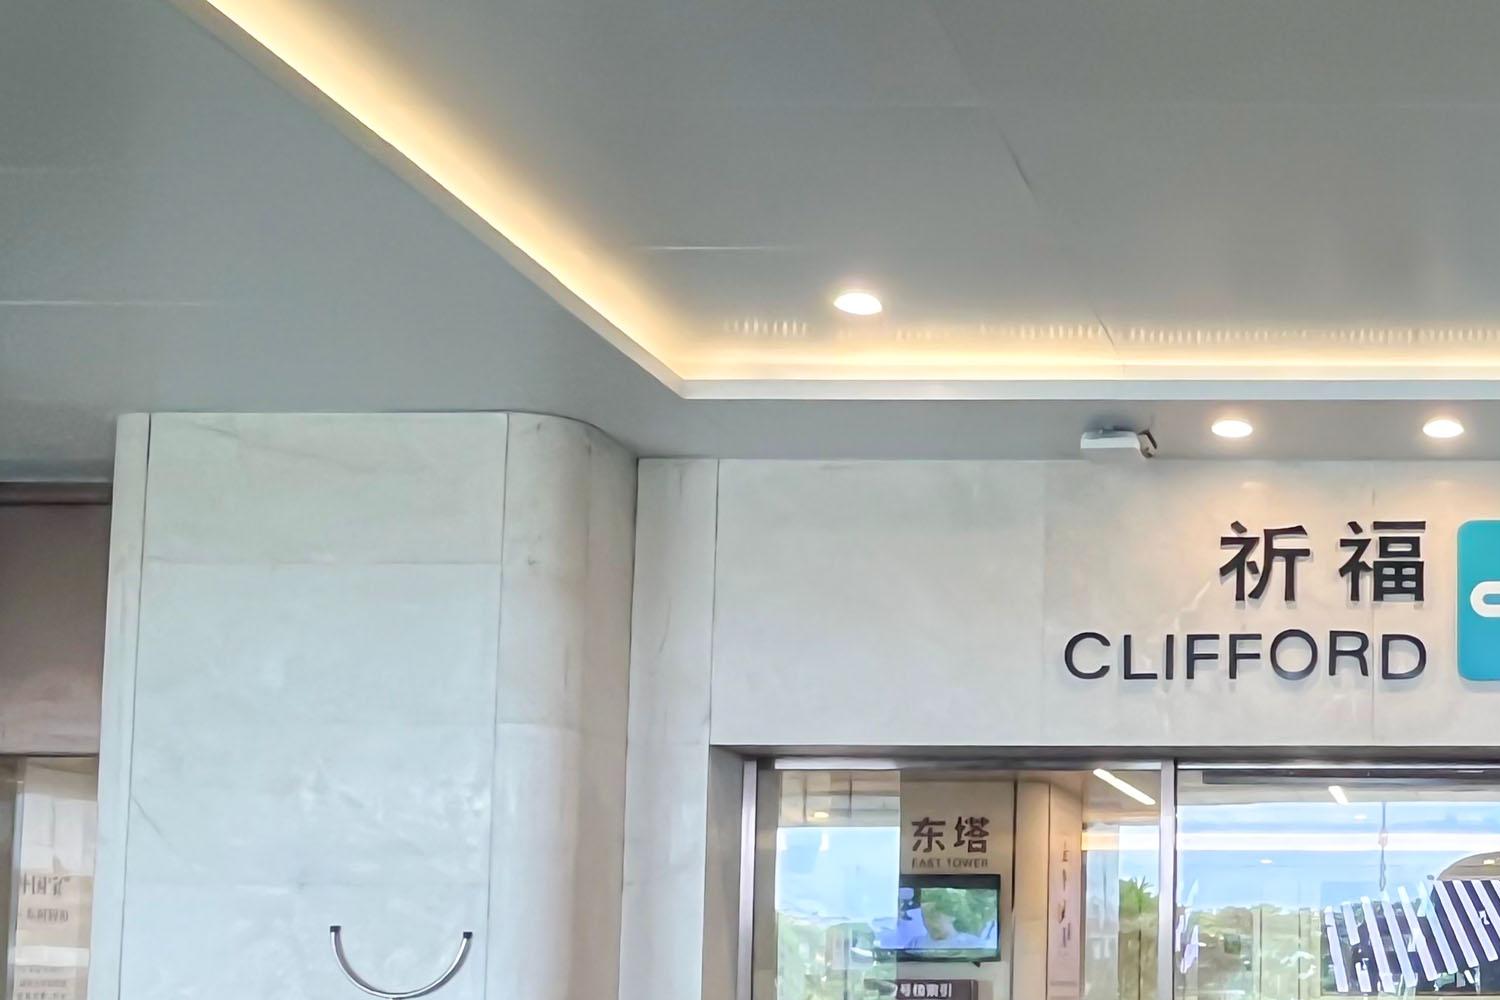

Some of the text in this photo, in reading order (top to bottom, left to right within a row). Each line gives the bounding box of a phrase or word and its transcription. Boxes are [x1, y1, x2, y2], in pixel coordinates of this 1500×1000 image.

[1219, 521, 1427, 602] 祈福
[1064, 629, 1427, 681] CLIFFORD
[911, 816, 990, 853] 东塔
[911, 857, 988, 868] EAST TOWER
